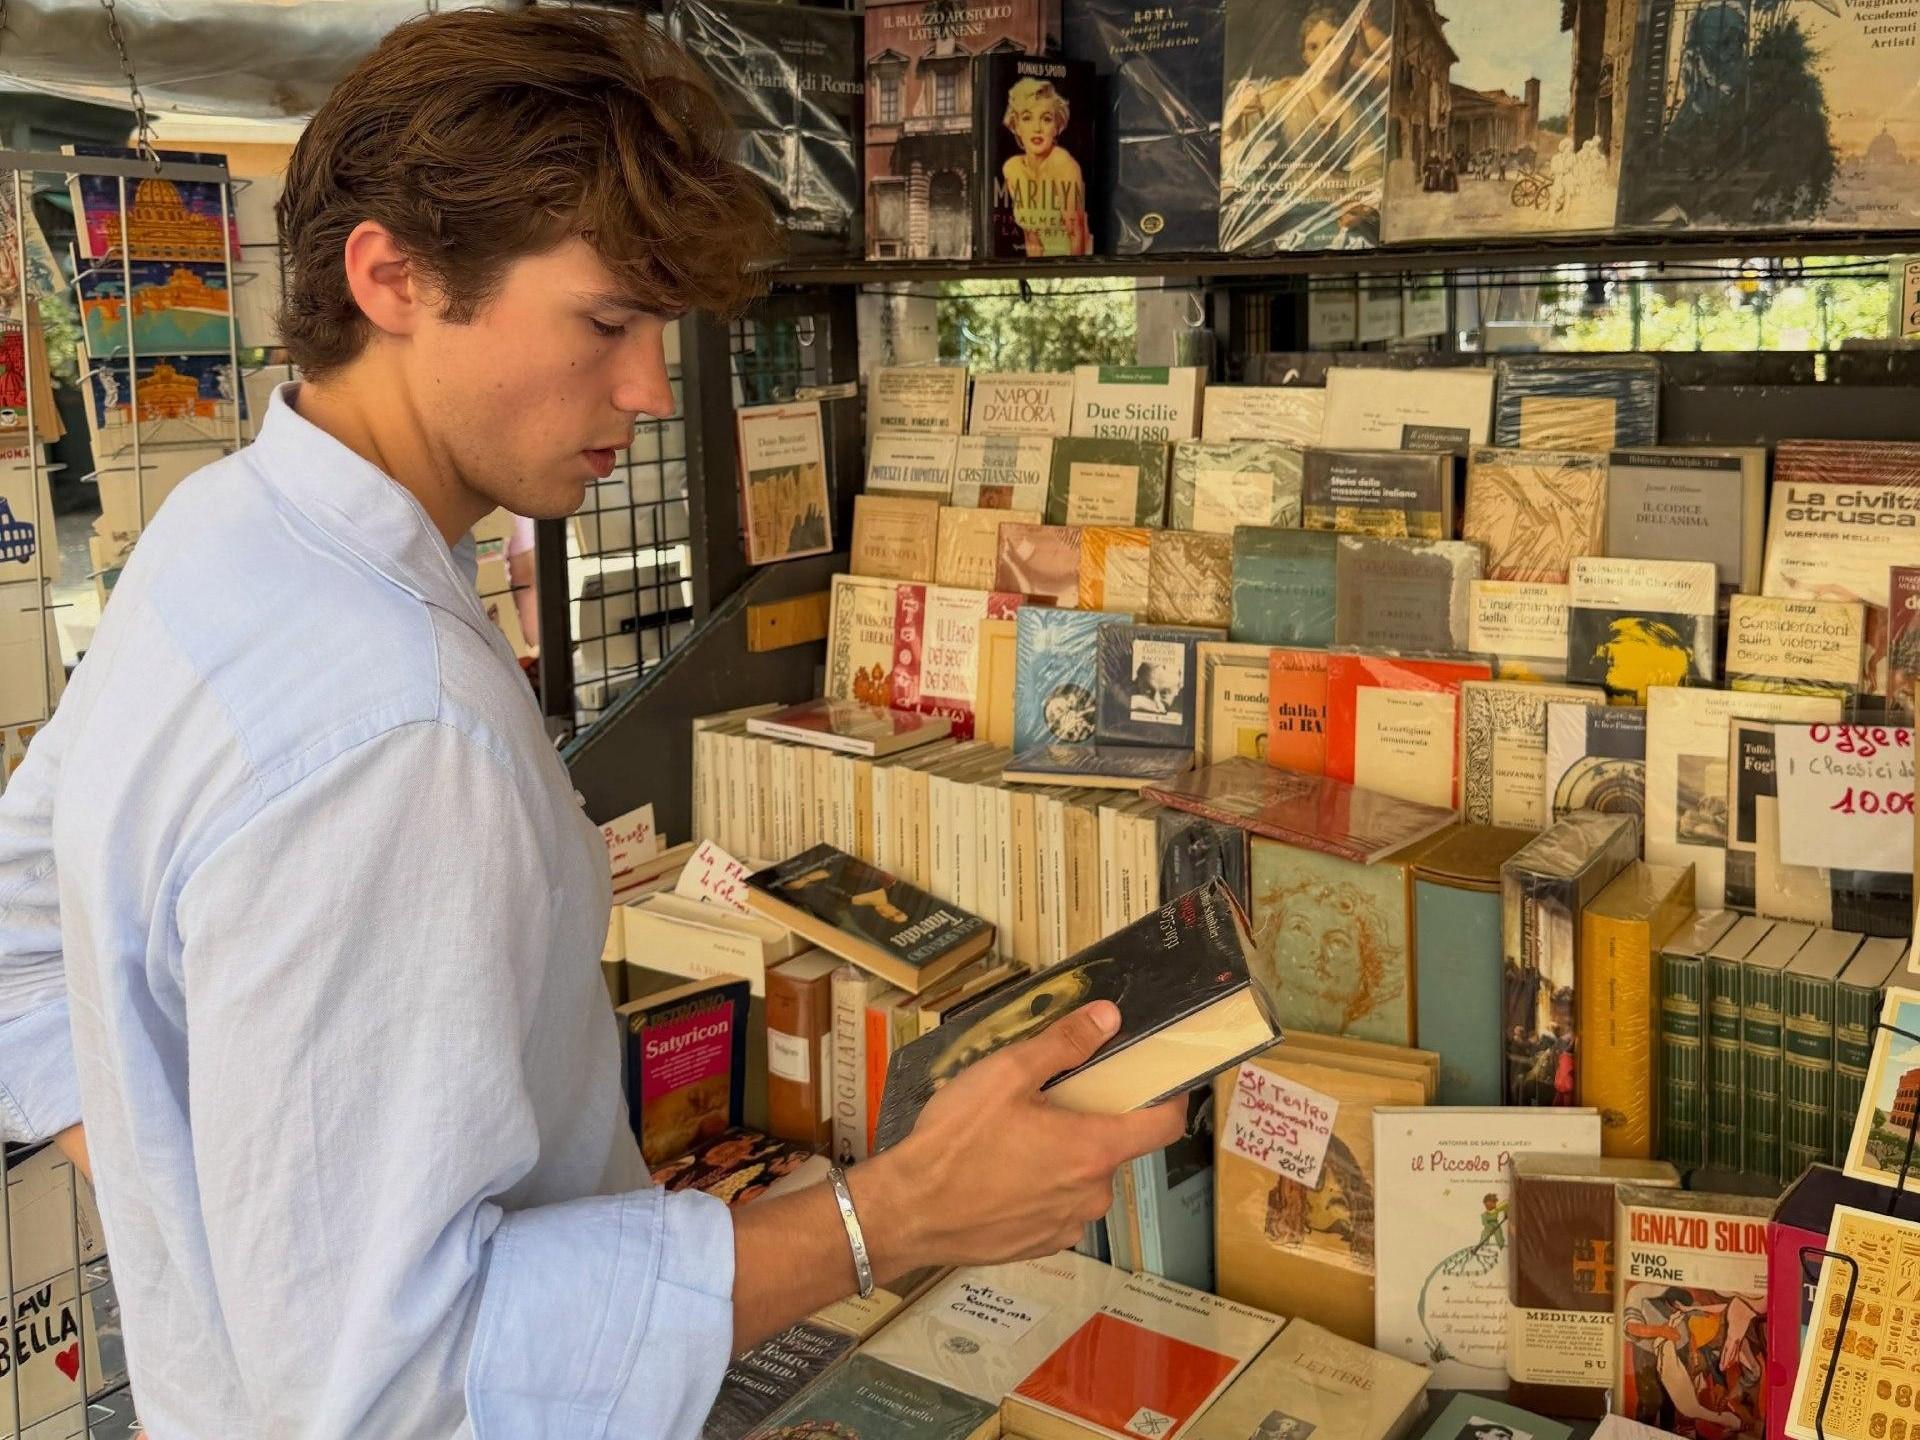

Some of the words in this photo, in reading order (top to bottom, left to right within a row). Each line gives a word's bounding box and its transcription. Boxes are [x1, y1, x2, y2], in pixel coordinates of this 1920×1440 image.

[883, 16, 895, 28] IL
[895, 13, 945, 27] PALAZZO
[948, 6, 1012, 23] APOSTOLICO
[1853, 8, 1919, 22] Accademie
[1863, 22, 1917, 35] Letterati
[1871, 36, 1916, 48] Artisti
[742, 69, 798, 90] Atlan
[803, 75, 816, 91] di
[820, 77, 865, 95] Roma
[993, 176, 1085, 212] MARILYN
[994, 388, 1050, 405] NAPOLI
[982, 405, 1056, 422] D'ALLORA
[1087, 402, 1121, 419] Due
[1125, 402, 1178, 421] Sicilie
[1092, 424, 1169, 441] 1830/1880
[958, 467, 1040, 485] CRISTIANESIMO
[1330, 476, 1356, 487] Storia
[1358, 476, 1381, 487] della
[1330, 487, 1381, 497] massoneria
[1383, 487, 1417, 499] italiana
[1787, 488, 1825, 506] La
[1643, 502, 1654, 512] IL
[1656, 503, 1702, 515] CODICE
[1786, 507, 1917, 527] etrusca
[1635, 514, 1711, 527] DELL'ANIMA
[1784, 530, 1840, 540] WERNER
[1478, 612, 1507, 623] della
[1739, 616, 1849, 637] Considerazioni
[1737, 633, 1772, 647] sulla
[1780, 636, 1840, 652] violenza
[1784, 652, 1815, 665] Sorel
[1224, 689, 1231, 701] Il
[1234, 691, 1269, 704] mondo
[1279, 702, 1317, 717] dalla
[1279, 717, 1295, 731] al
[1377, 723, 1387, 731] La
[1809, 756, 1893, 779] Classici
[890, 909, 963, 947] Traviata
[645, 1021, 729, 1059] Satyricon
[837, 1005, 857, 1131] TOGLIATTI
[1411, 1154, 1424, 1172] il
[1429, 1150, 1491, 1172] Piccolo
[1630, 1211, 1708, 1249] IGNAZIO
[1631, 1252, 1668, 1267] VINO
[1630, 1265, 1640, 1276] E
[1644, 1266, 1684, 1281] PANE
[1123, 1283, 1173, 1305] Psicologia
[1176, 1301, 1211, 1317] sociale
[1110, 1307, 1144, 1323] Mulino
[1228, 1303, 1276, 1324] Backman
[1292, 1352, 1376, 1392] LETTERE
[725, 1368, 780, 1396] Garzanti
